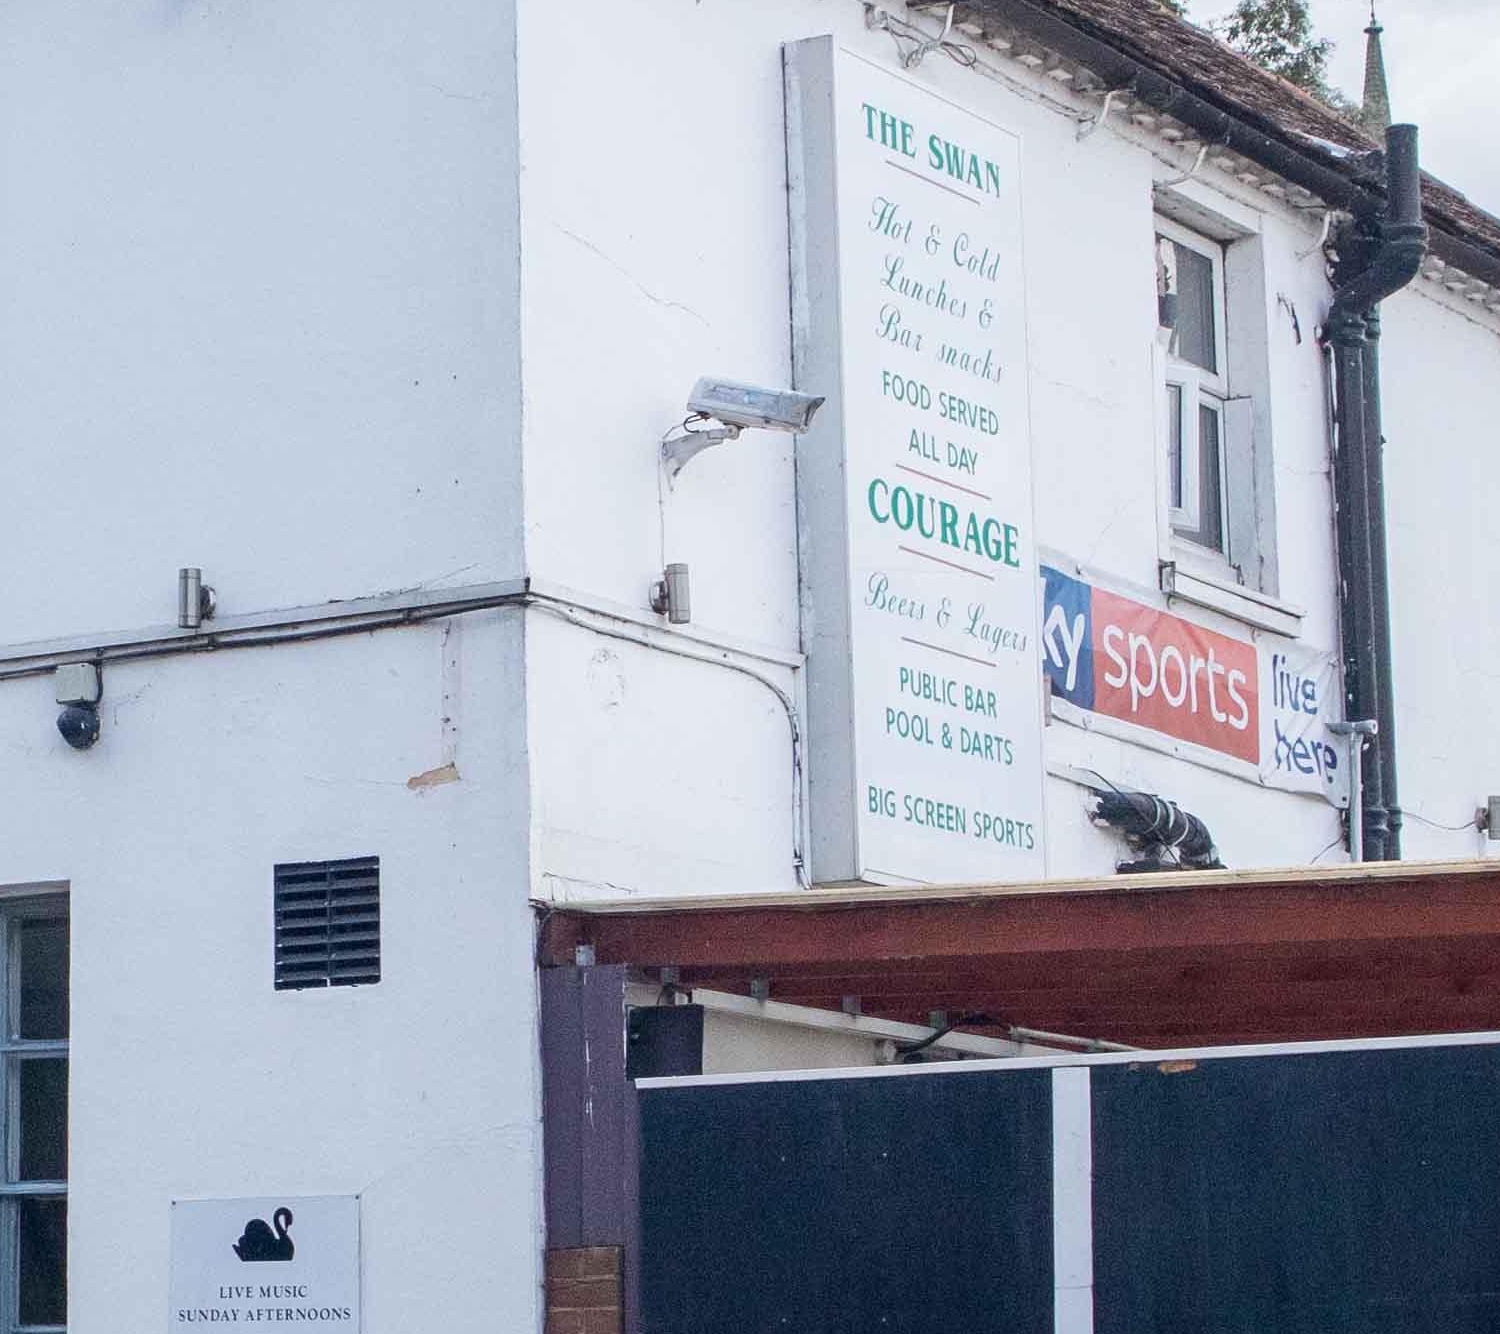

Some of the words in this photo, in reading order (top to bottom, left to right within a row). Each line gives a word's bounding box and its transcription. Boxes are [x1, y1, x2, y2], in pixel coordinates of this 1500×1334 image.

[861, 102, 917, 160] THE
[928, 134, 1001, 199] SWAN
[867, 195, 913, 245] Hot
[924, 223, 942, 256] &
[953, 233, 1001, 283] Cold
[879, 253, 968, 320] Lunches
[978, 298, 994, 330] &
[875, 302, 923, 355] Bar
[937, 339, 1003, 385] snacks
[882, 370, 932, 411] FOOD
[938, 391, 1000, 437] SERVED
[908, 427, 941, 463] ALL
[946, 441, 979, 476] DAY
[867, 478, 1021, 568] COURAGE
[864, 570, 926, 622] Beers
[936, 597, 952, 629] &
[963, 601, 1029, 653] Lagers
[1040, 576, 1086, 692] ky
[1104, 624, 1248, 730] sports
[1272, 654, 1318, 715] live
[900, 667, 958, 708] PUBLIC
[964, 686, 998, 719] BAR
[886, 707, 934, 748] POOL
[942, 723, 954, 750] &
[960, 727, 1014, 766] DARTS
[1274, 718, 1338, 784] here
[868, 786, 897, 819] BIG
[904, 794, 967, 835] SCREEN
[974, 810, 1035, 850] SPORTS
[178, 1308, 241, 1323] SUNDAY
[245, 1306, 352, 1322] AFTERNOONS
[219, 1285, 254, 1300] LIVE
[259, 1284, 308, 1300] MUSIC
